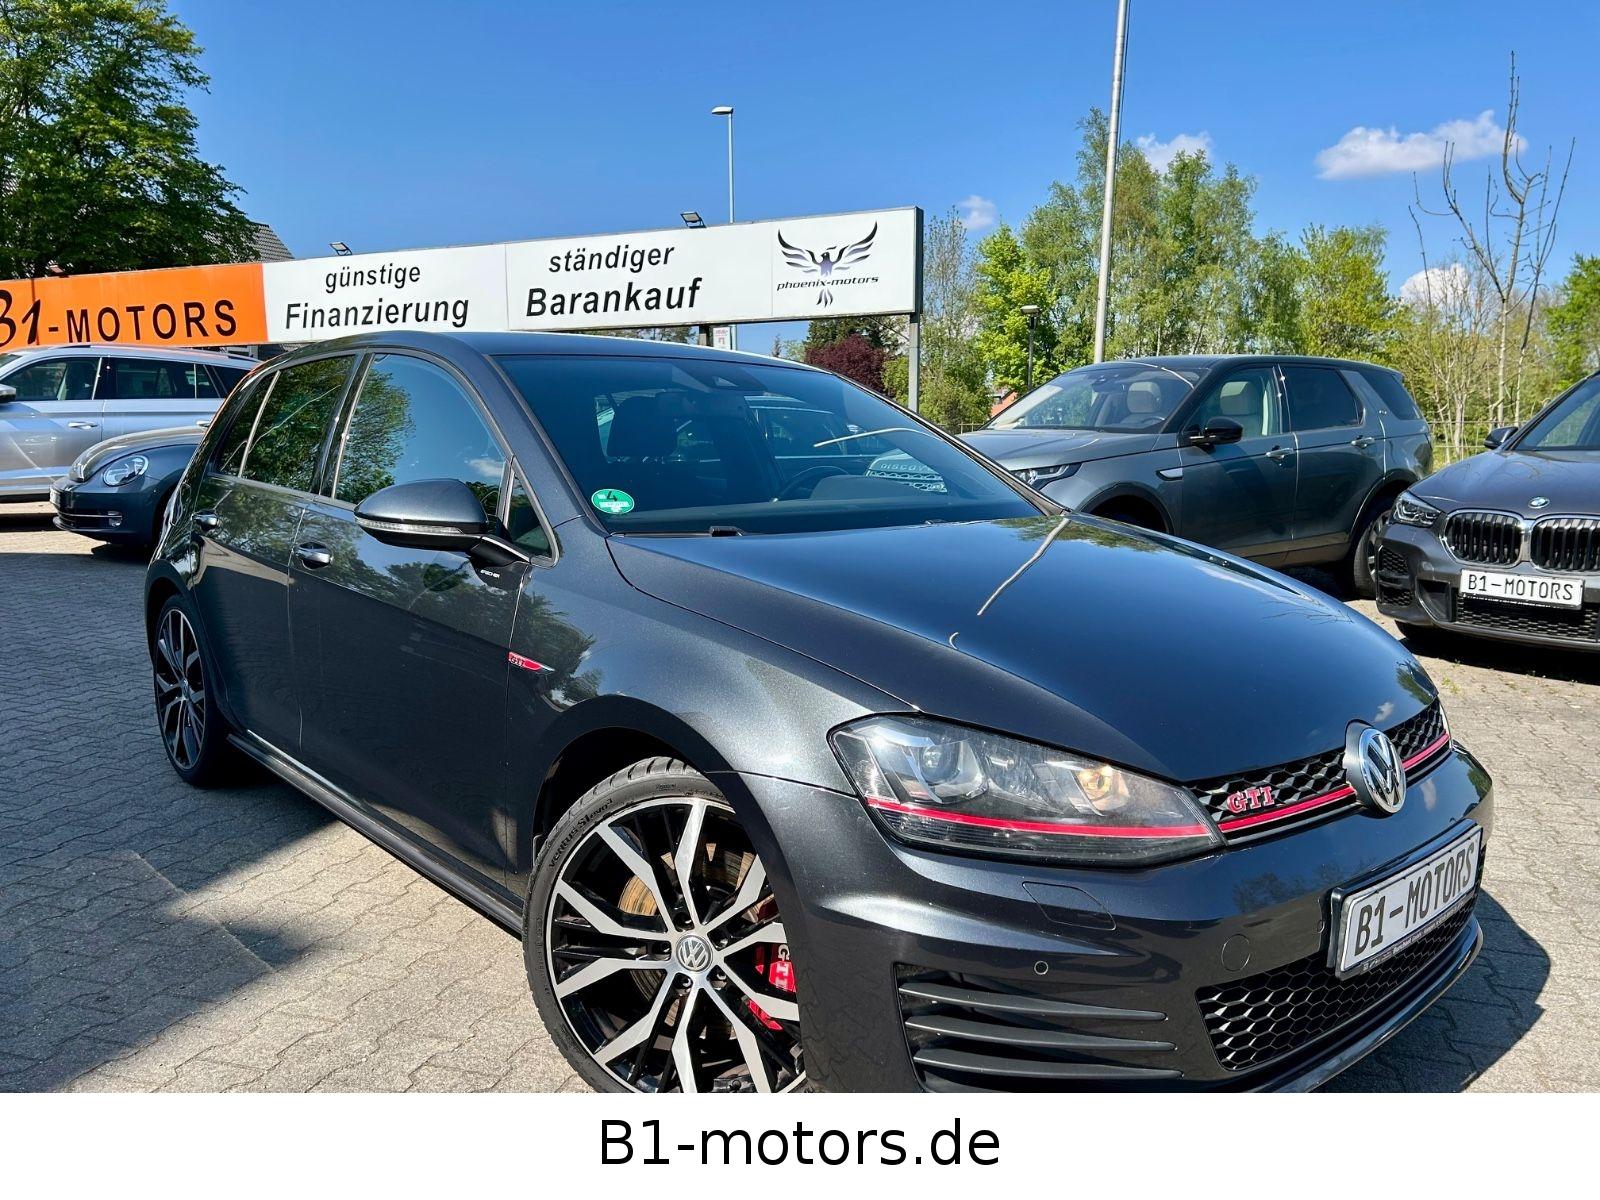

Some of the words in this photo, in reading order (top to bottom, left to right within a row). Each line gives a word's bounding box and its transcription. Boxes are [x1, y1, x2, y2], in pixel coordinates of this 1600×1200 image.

[549, 244, 676, 273] ständiger
[325, 263, 421, 293] günstige
[776, 276, 879, 291] phoenix-motors
[526, 277, 702, 317] Barankauf
[286, 298, 469, 329] Finanzierung
[1468, 574, 1573, 601] B1-MOTORS
[1226, 785, 1275, 814] GTI
[1354, 842, 1475, 957] B1-MOTORS
